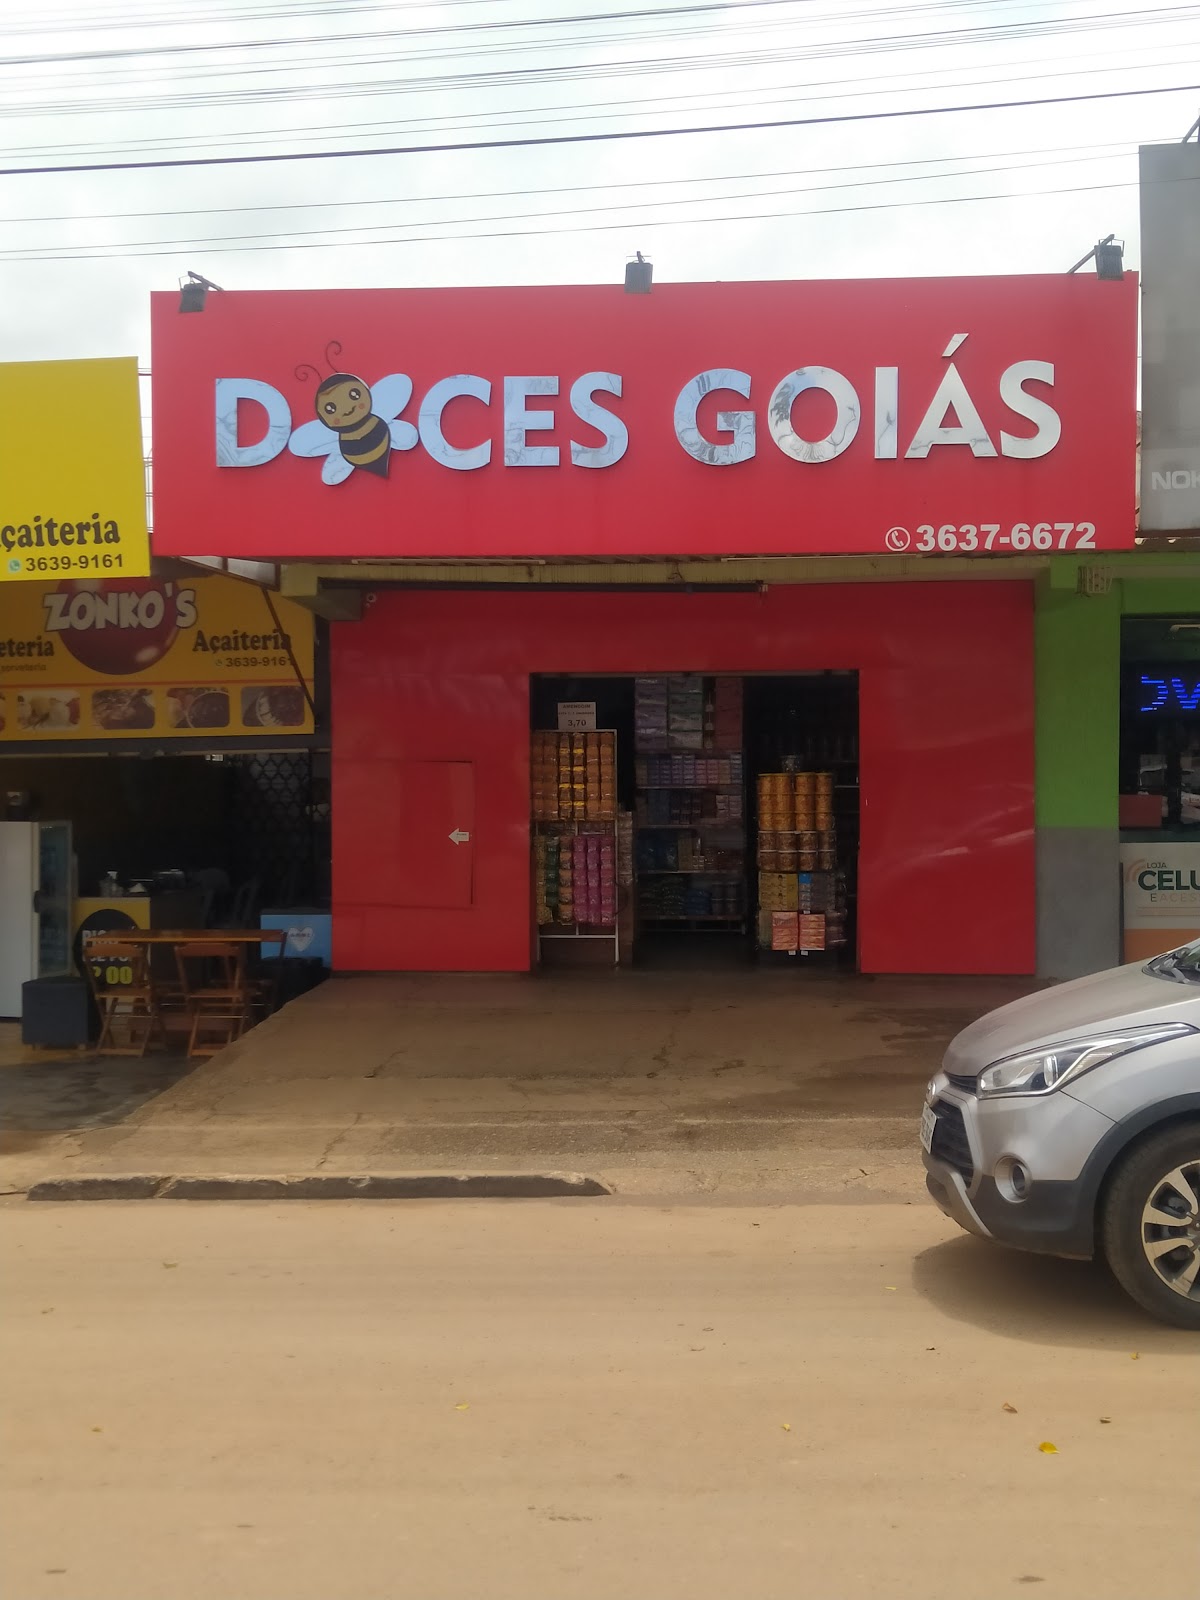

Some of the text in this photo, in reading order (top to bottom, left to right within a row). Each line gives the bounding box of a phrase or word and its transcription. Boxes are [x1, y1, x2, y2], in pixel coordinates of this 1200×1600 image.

[215, 333, 1062, 470] DCES GOIÁS
[0, 512, 121, 551] çaiteria
[916, 522, 1096, 551] 3637-6672
[25, 553, 124, 572] 3639-9161
[43, 583, 197, 631] ZONKO'S
[192, 629, 293, 654] Açaiteria
[567, 719, 587, 728] 3,70
[1159, 893, 1200, 903] ACES
